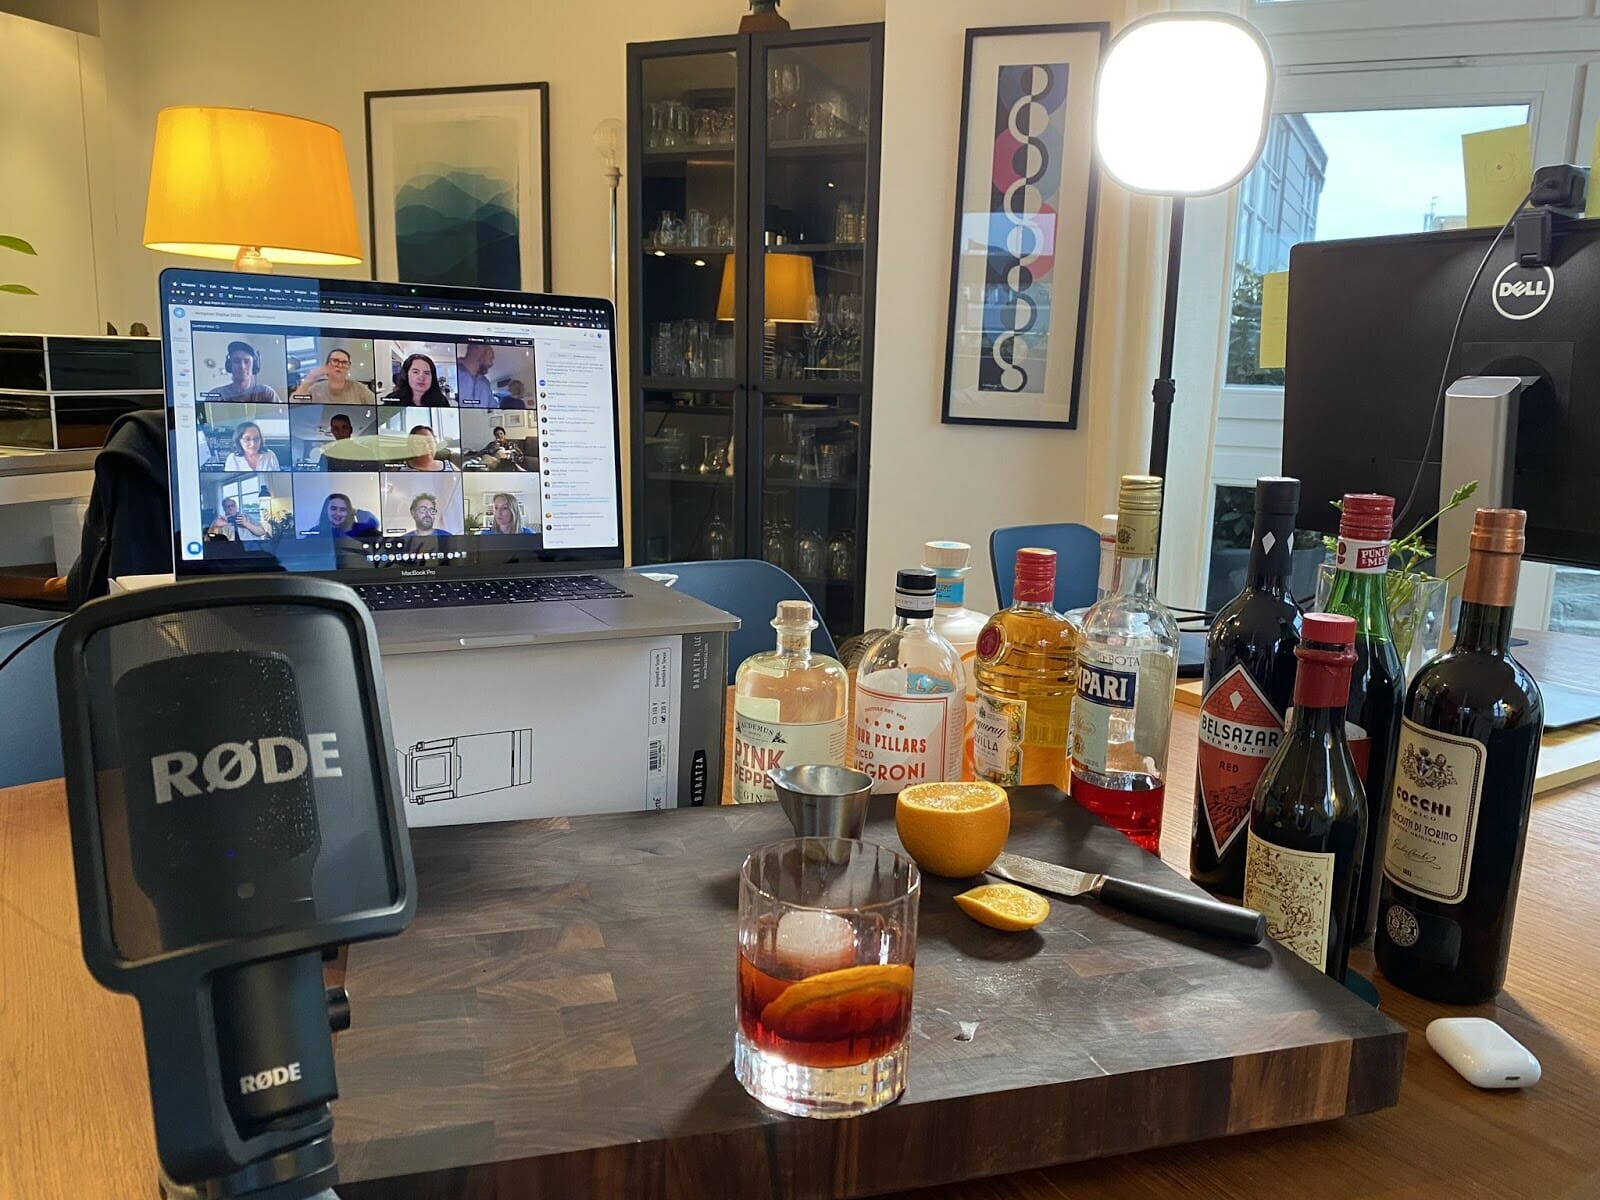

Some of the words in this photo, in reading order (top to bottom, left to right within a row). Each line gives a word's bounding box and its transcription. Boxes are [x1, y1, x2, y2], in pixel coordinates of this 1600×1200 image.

[1499, 281, 1546, 297] DELL
[1361, 548, 1386, 558] PUNT
[1080, 667, 1128, 700] PARI
[874, 733, 927, 754] PILLARS
[1202, 715, 1279, 747] BELSAZAR
[735, 738, 785, 771] PINK
[976, 735, 999, 753] VILLA
[1207, 735, 1264, 754] VERMOUTH
[151, 732, 342, 804] RØDE
[694, 757, 704, 802] BARATZA
[734, 762, 776, 791] PEPPE
[1219, 761, 1239, 773] RED
[743, 791, 762, 804] GIN
[1396, 785, 1452, 818] COCCHI
[1414, 821, 1422, 832] DI
[1424, 825, 1458, 843] TORINO
[240, 1062, 302, 1095] RØDE
